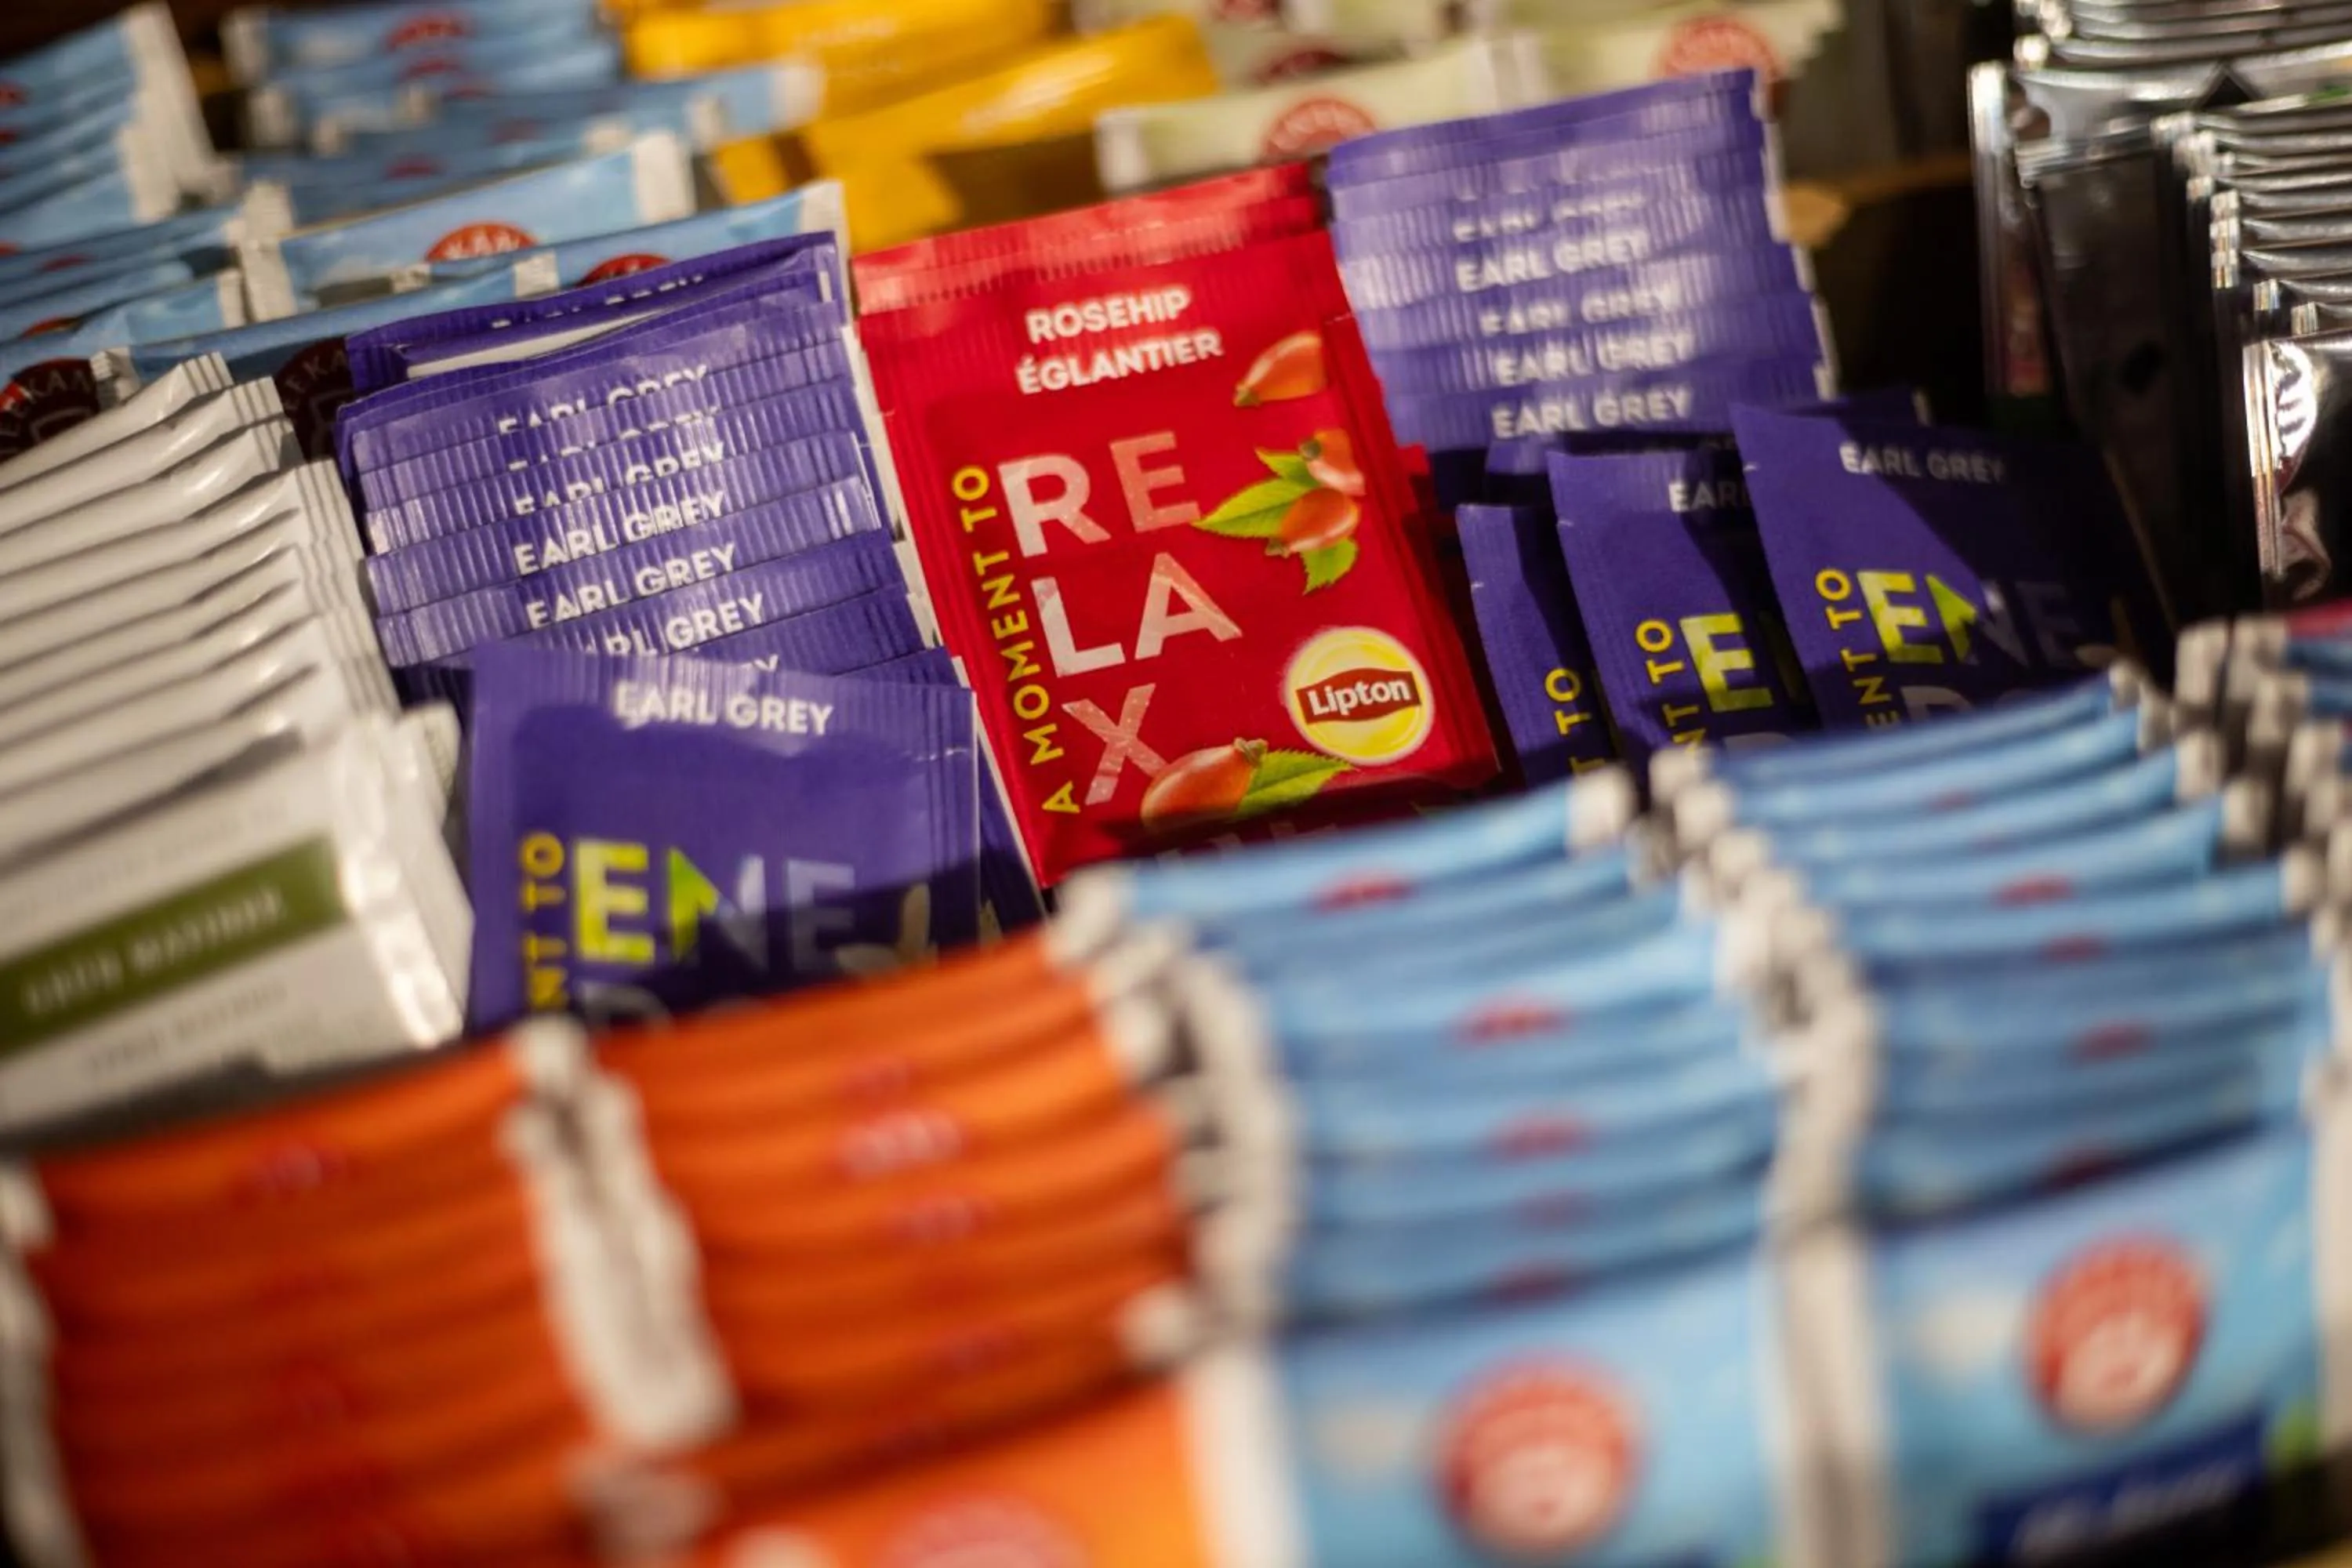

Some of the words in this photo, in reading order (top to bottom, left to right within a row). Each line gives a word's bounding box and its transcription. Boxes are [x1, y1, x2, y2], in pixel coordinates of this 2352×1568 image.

[1456, 249, 1552, 292] EARL
[1553, 229, 1649, 274] GREY
[1025, 285, 1191, 344] ROSEHIP
[1015, 328, 1224, 394] ÉGLANTIER
[1495, 341, 1593, 386] EARL
[1596, 330, 1695, 372] GREY
[1492, 398, 1587, 439] EARL
[1593, 385, 1691, 427] GREY
[1839, 441, 1921, 477] EARL
[1926, 450, 2007, 483] GREY
[952, 466, 997, 532] TO
[514, 524, 618, 575] EARL
[624, 491, 724, 543] GREY
[525, 579, 629, 629] EARL
[635, 543, 735, 596] GREY
[1814, 568, 1864, 630] TO
[666, 593, 764, 649] GREY
[1635, 619, 1686, 685] TO
[972, 550, 1064, 765] MOMENT
[615, 679, 717, 728] EARL
[726, 694, 833, 735] GREY
[1307, 679, 1410, 717] Lipton
[1544, 667, 1593, 736] TO
[1041, 780, 1080, 814] A
[521, 832, 566, 913] TO
